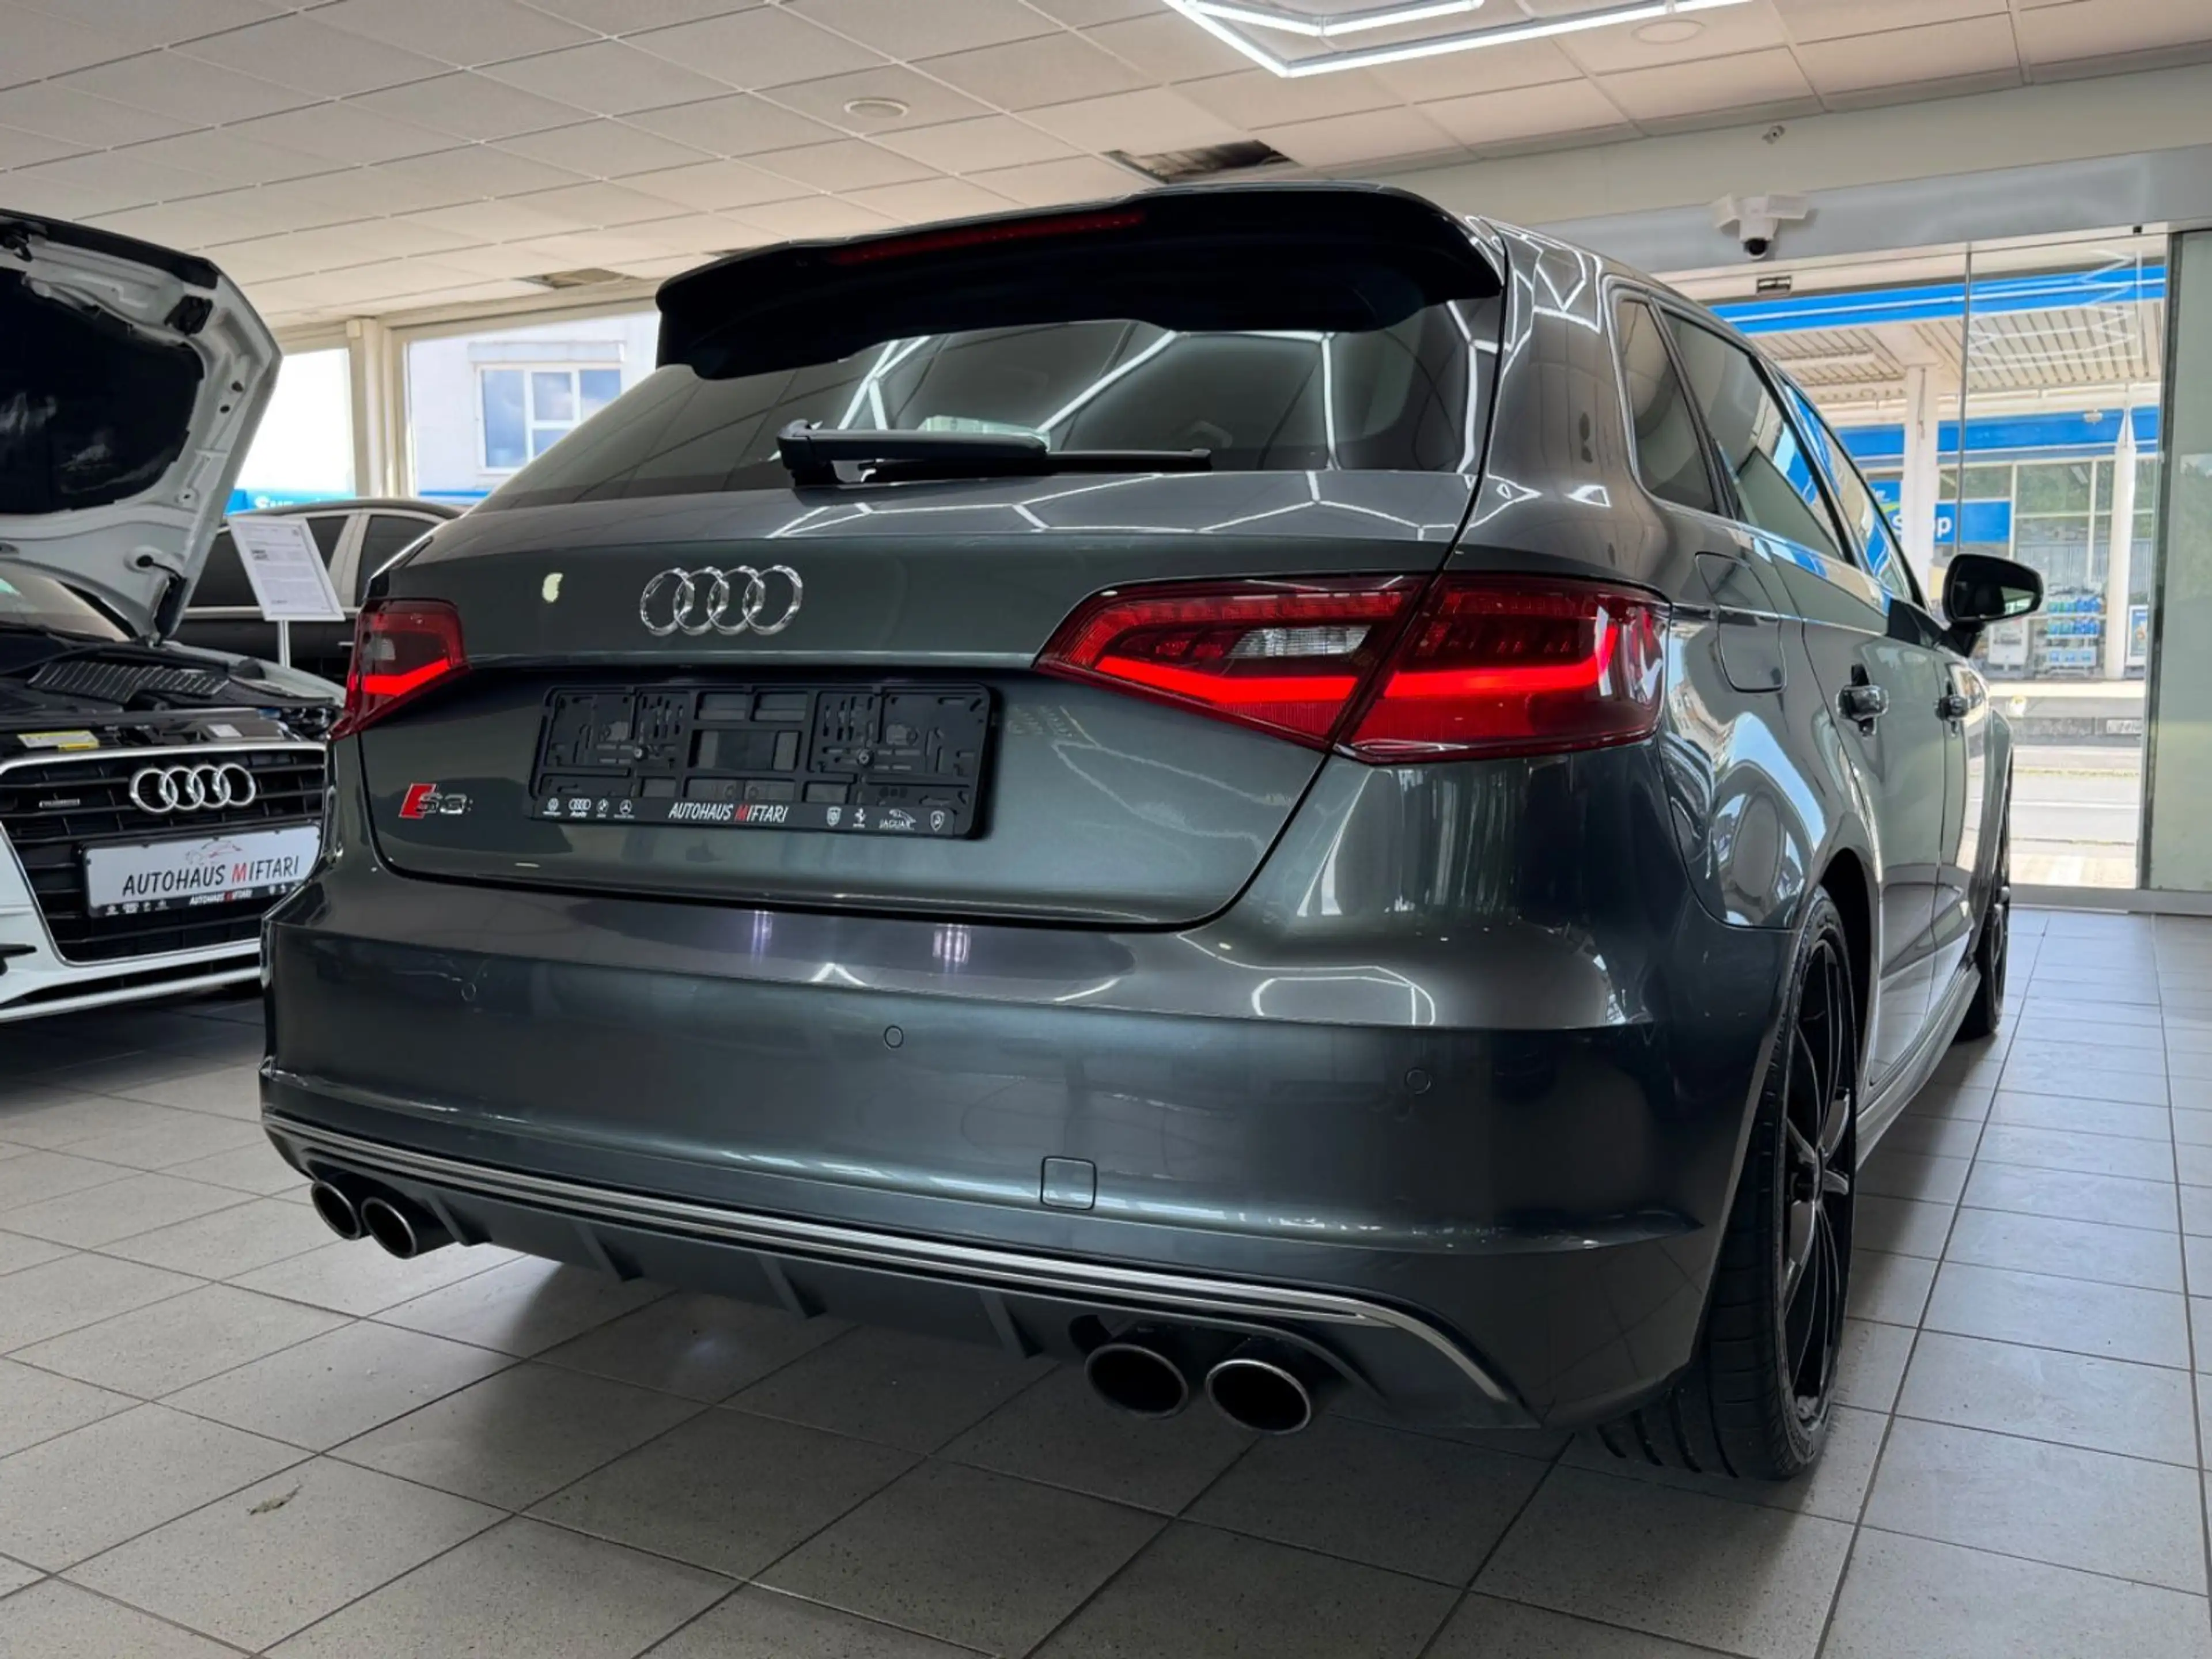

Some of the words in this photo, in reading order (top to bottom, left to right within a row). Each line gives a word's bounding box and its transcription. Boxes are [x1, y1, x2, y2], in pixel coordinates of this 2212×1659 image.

[1892, 514, 1952, 539] Sp
[415, 789, 468, 816] S3
[668, 802, 734, 821] AUTOHAUS
[734, 804, 789, 823] MIFTARI
[122, 864, 225, 897] AUTOHAUS
[232, 855, 300, 882] MIFTARI
